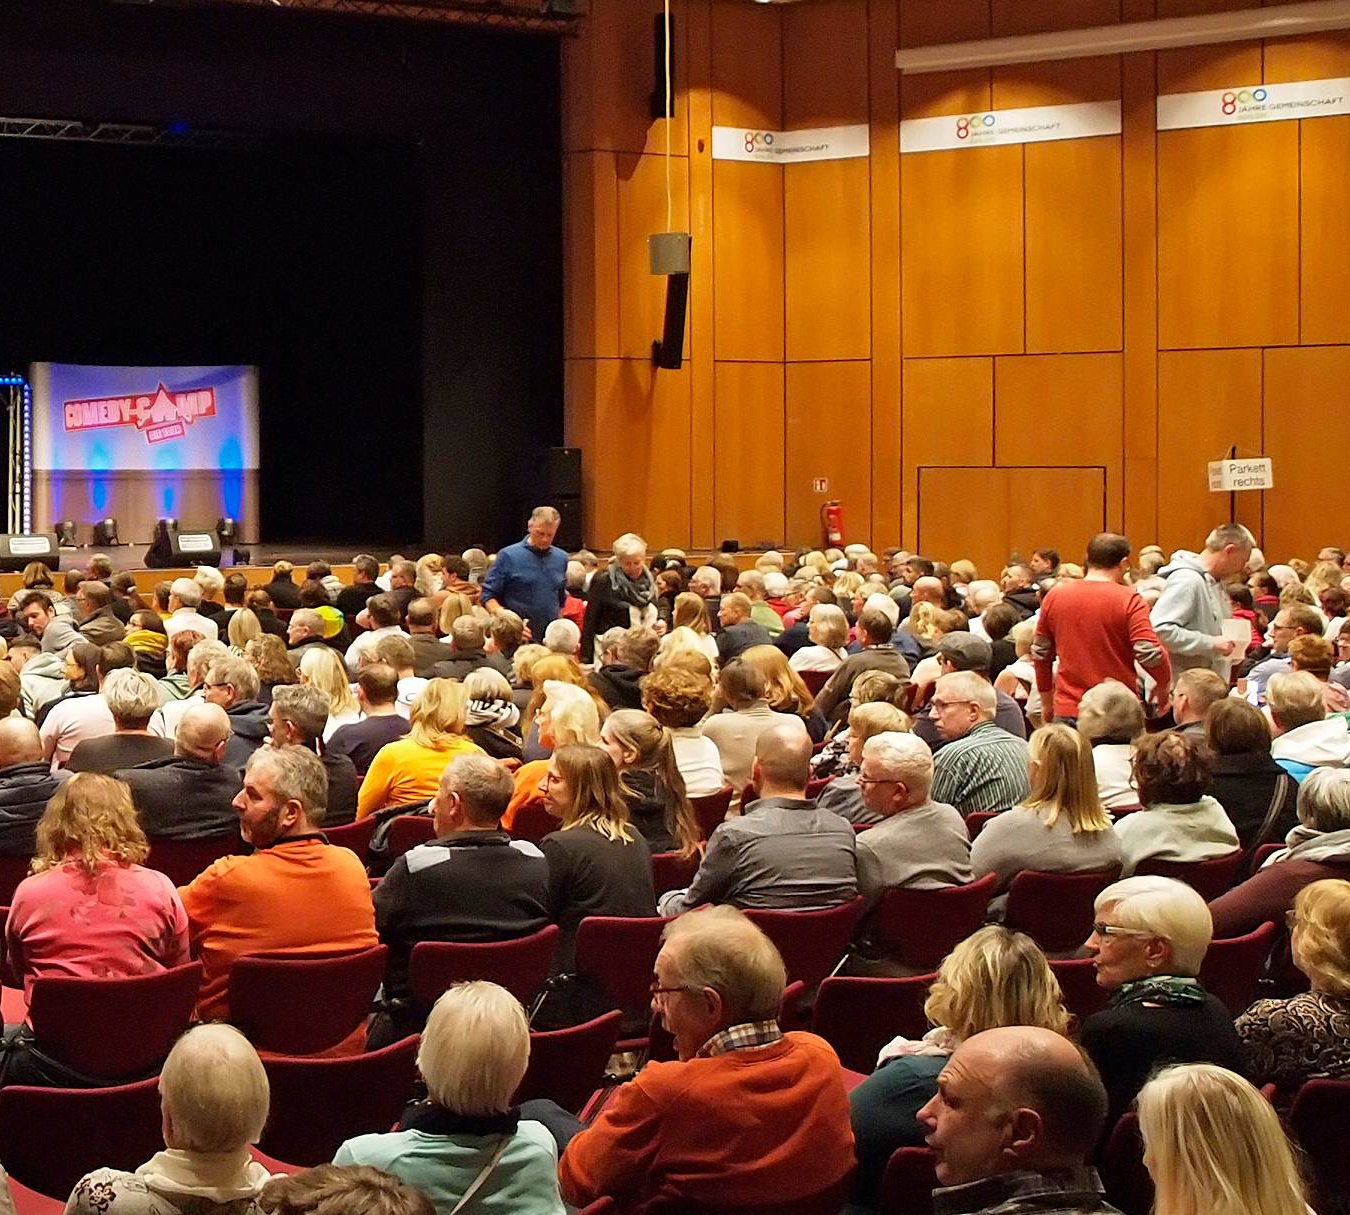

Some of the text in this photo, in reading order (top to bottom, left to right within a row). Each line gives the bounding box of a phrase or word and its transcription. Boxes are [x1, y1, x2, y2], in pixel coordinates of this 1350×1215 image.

[1238, 96, 1343, 113] JAHRE GEMEINSCHAFT
[64, 388, 214, 429] COMEDY-CAMP
[1229, 463, 1267, 474] Parkett
[1233, 476, 1265, 487] rechts
